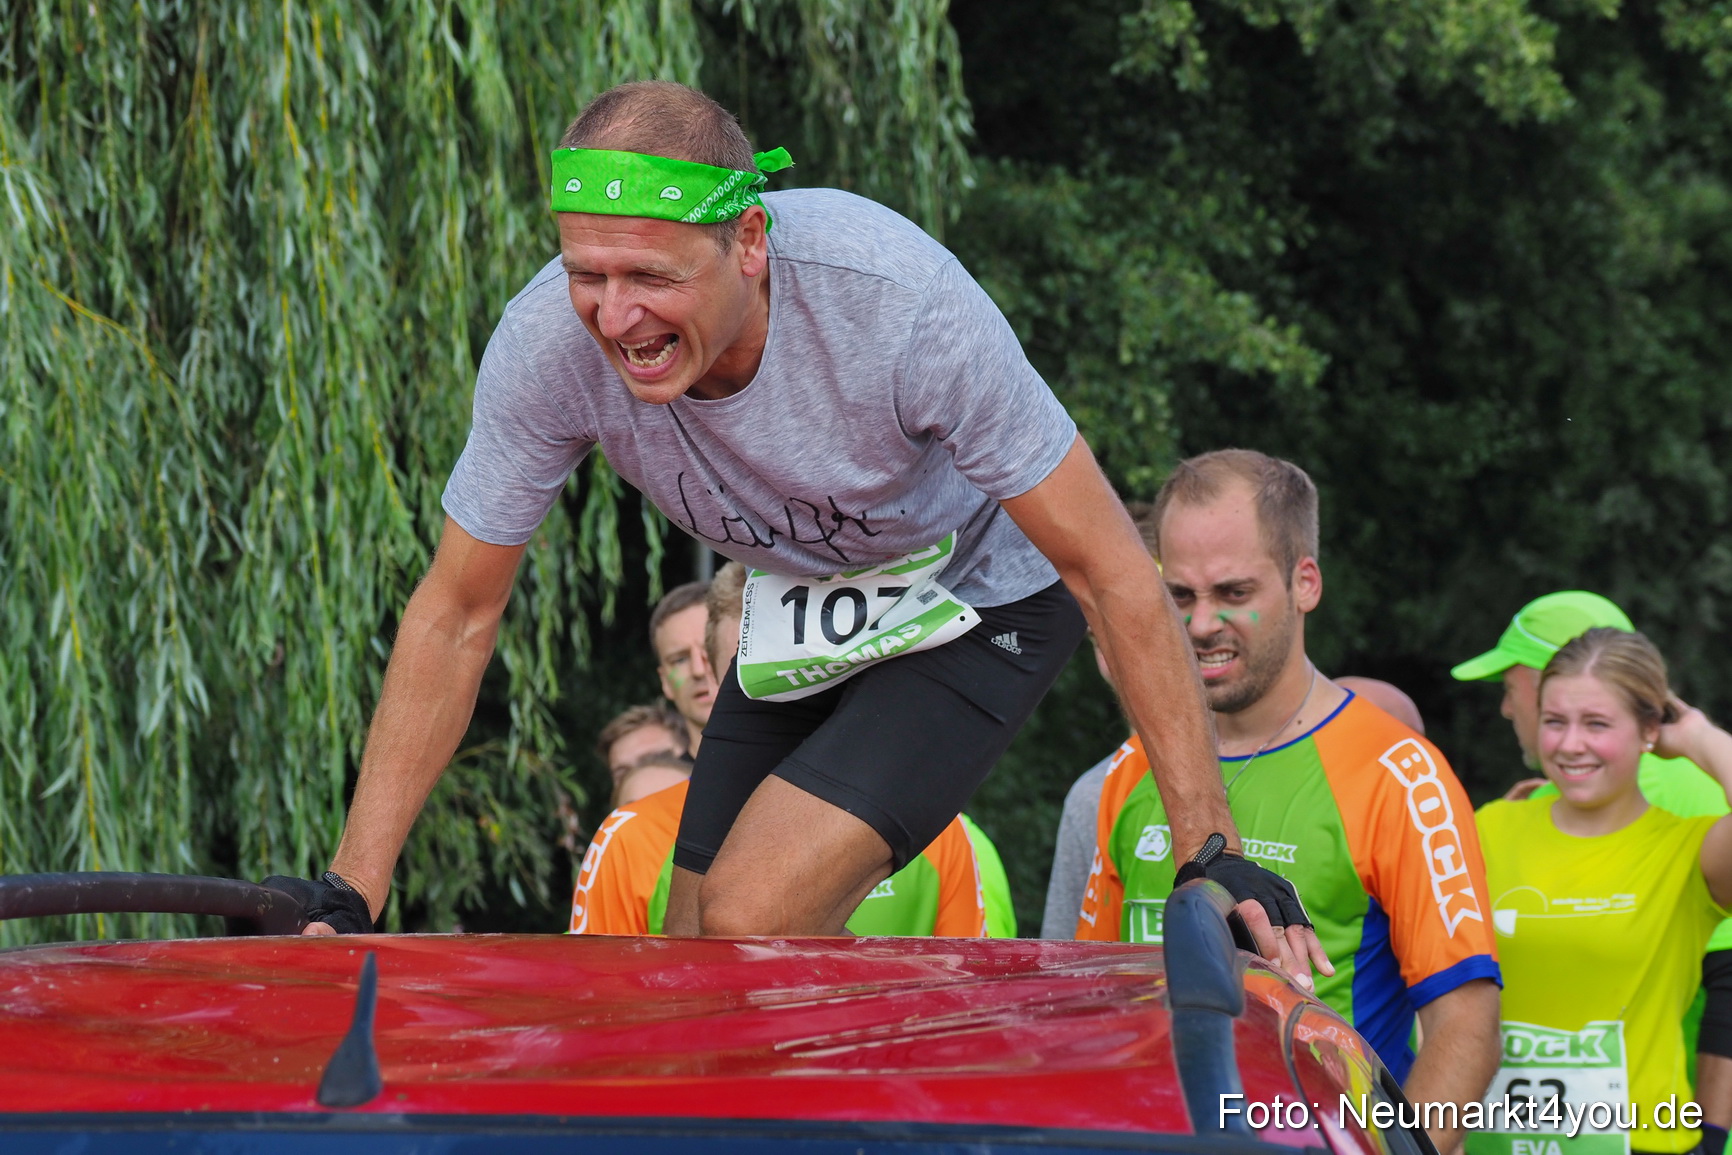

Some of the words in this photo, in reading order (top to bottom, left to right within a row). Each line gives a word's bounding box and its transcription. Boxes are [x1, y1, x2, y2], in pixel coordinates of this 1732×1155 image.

[780, 584, 913, 646] 107
[776, 622, 923, 687] THOMAS
[990, 637, 1022, 655] adidas
[1378, 738, 1484, 939] BOCK
[1502, 1029, 1611, 1064] OCK
[1505, 1078, 1567, 1122] 63
[1511, 1139, 1564, 1155] EVA
